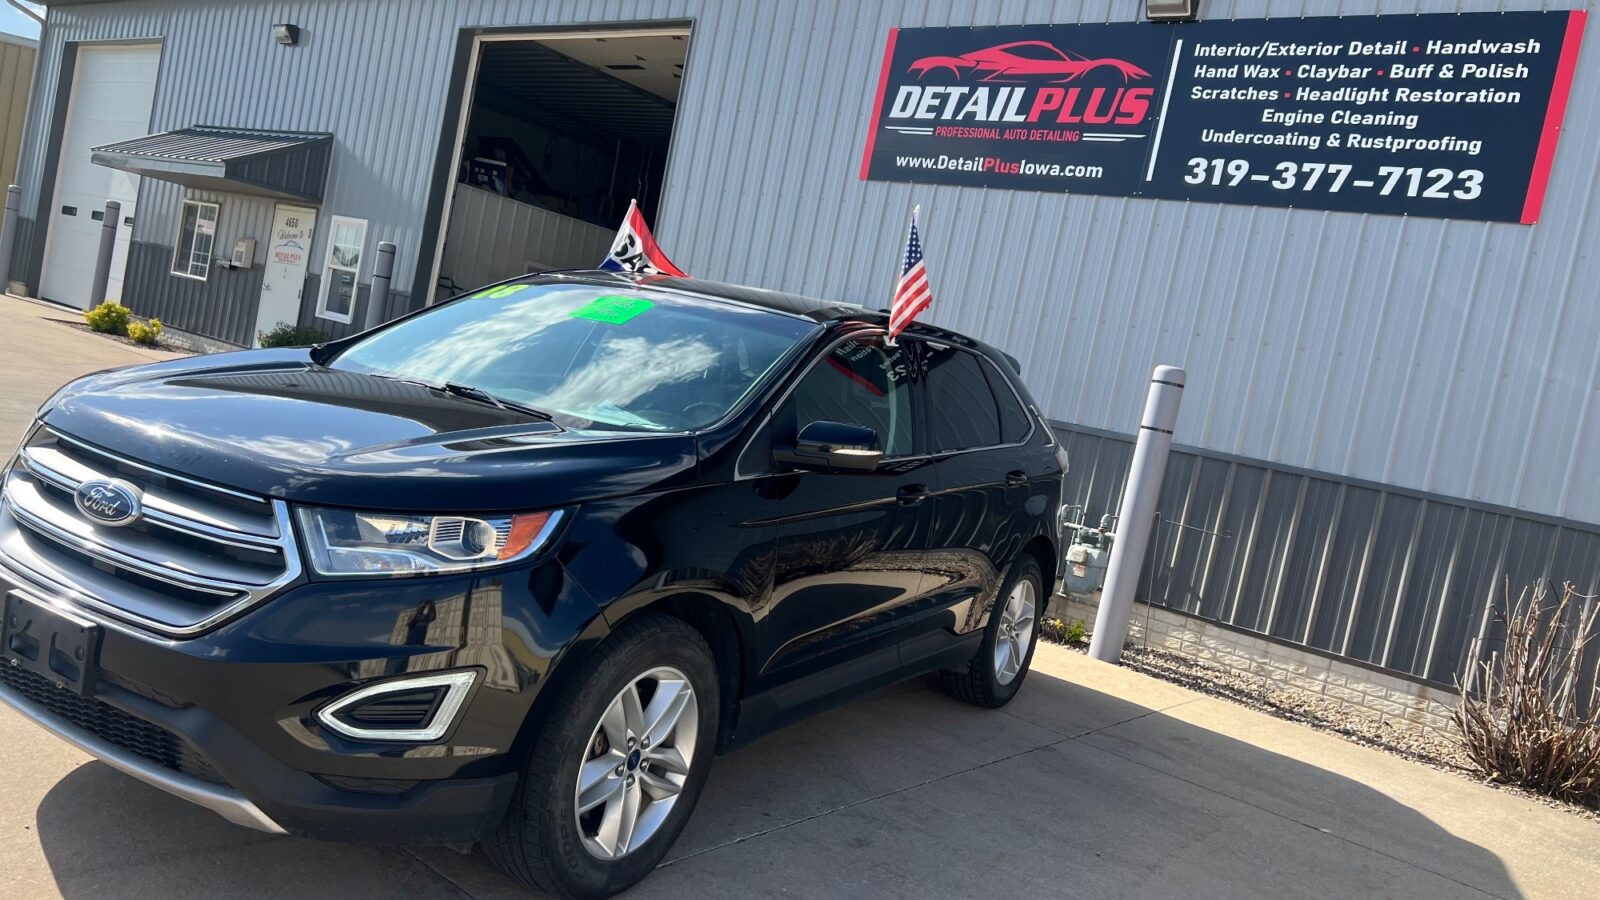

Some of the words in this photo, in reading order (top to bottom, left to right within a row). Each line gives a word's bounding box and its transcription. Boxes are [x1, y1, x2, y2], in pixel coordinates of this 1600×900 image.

[1194, 42, 1343, 58] Interior/Exterior
[1348, 41, 1408, 56] Detail
[1425, 38, 1541, 55] Handwash
[1193, 64, 1239, 79] Hand
[1243, 64, 1281, 79] Wax
[1296, 64, 1373, 81] Claybar
[1389, 63, 1434, 79] Buff
[1438, 63, 1455, 79] &
[1461, 63, 1529, 79] Polish
[1190, 86, 1280, 101] Scratches
[1295, 86, 1390, 105] Headlight
[1395, 87, 1521, 103] Restoration
[1261, 108, 1325, 126] Engine
[1330, 110, 1419, 129] Cleaning
[935, 126, 1001, 140] PROFESSIONAL
[1003, 128, 1028, 141] AUTO
[1029, 129, 1080, 142] DETAILING
[1201, 129, 1321, 149] Undercoating
[1326, 132, 1341, 148] &
[1347, 133, 1483, 155] Rustproofing
[896, 155, 1103, 178] www.DetailPlusIowa.com
[1184, 157, 1484, 200] 319-377-7123
[84, 486, 121, 516] Ford
